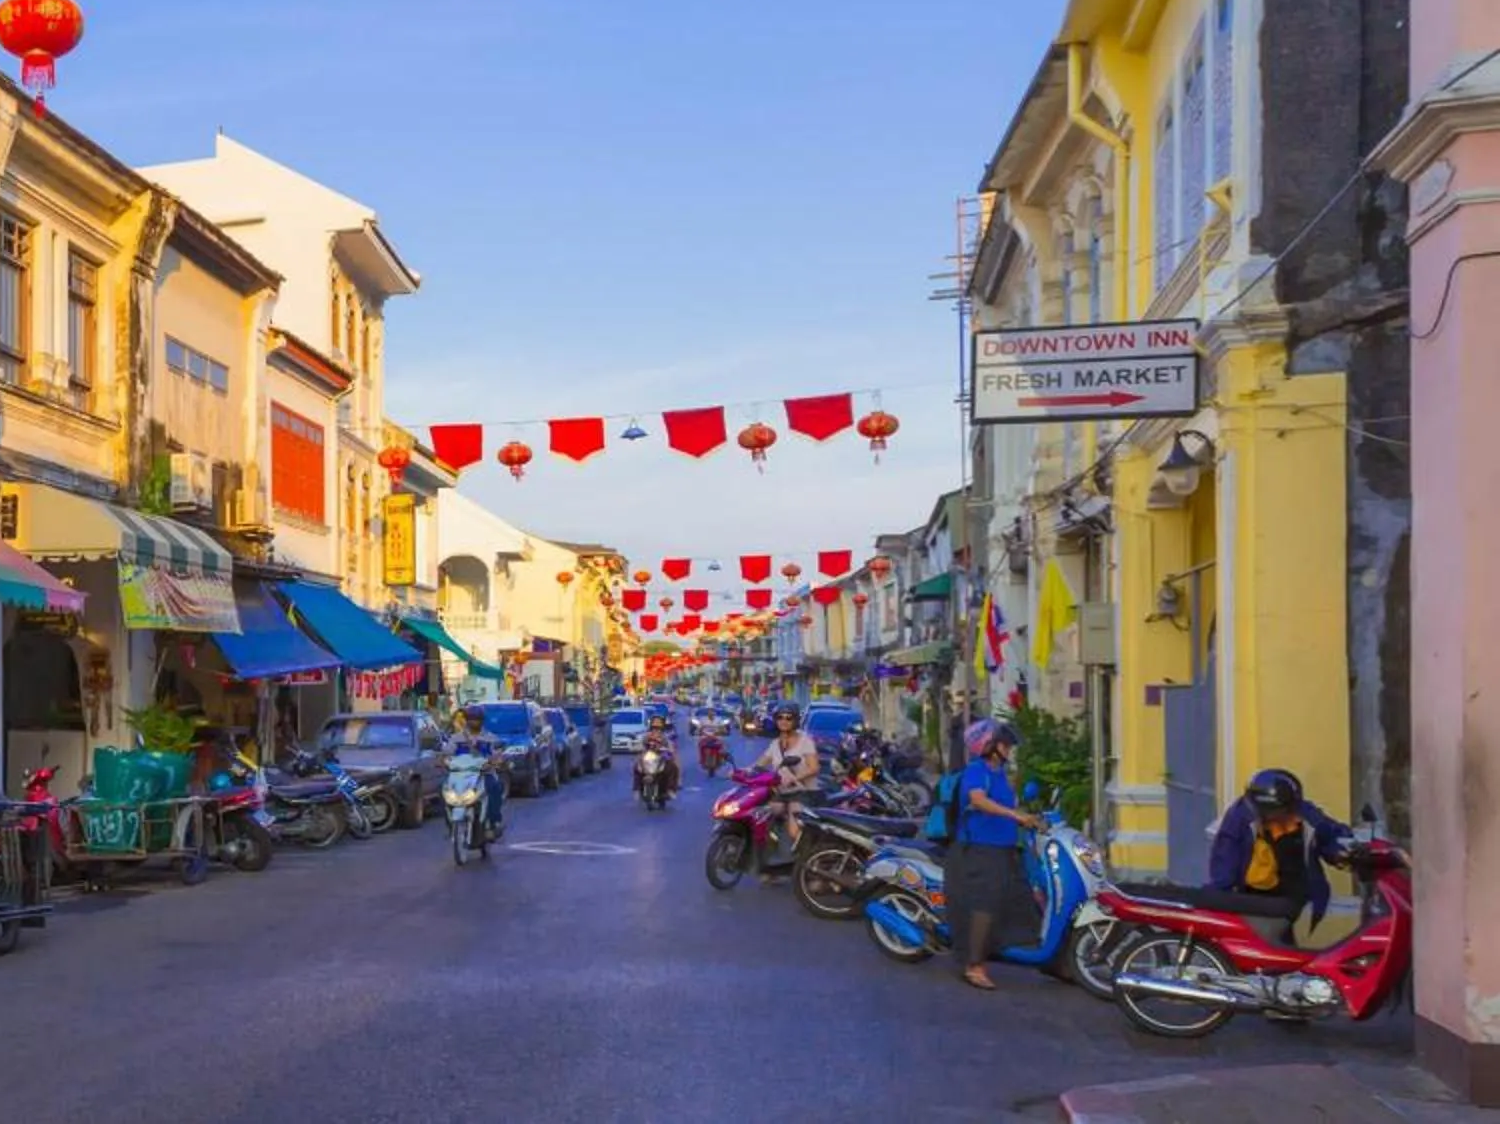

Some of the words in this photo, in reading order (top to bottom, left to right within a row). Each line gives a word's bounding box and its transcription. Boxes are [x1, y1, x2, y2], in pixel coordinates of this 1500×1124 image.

[984, 331, 1136, 357] DOWNTOWN
[1147, 329, 1189, 348] INN
[982, 371, 1062, 392] FRESH
[1074, 365, 1188, 388] MARKET
